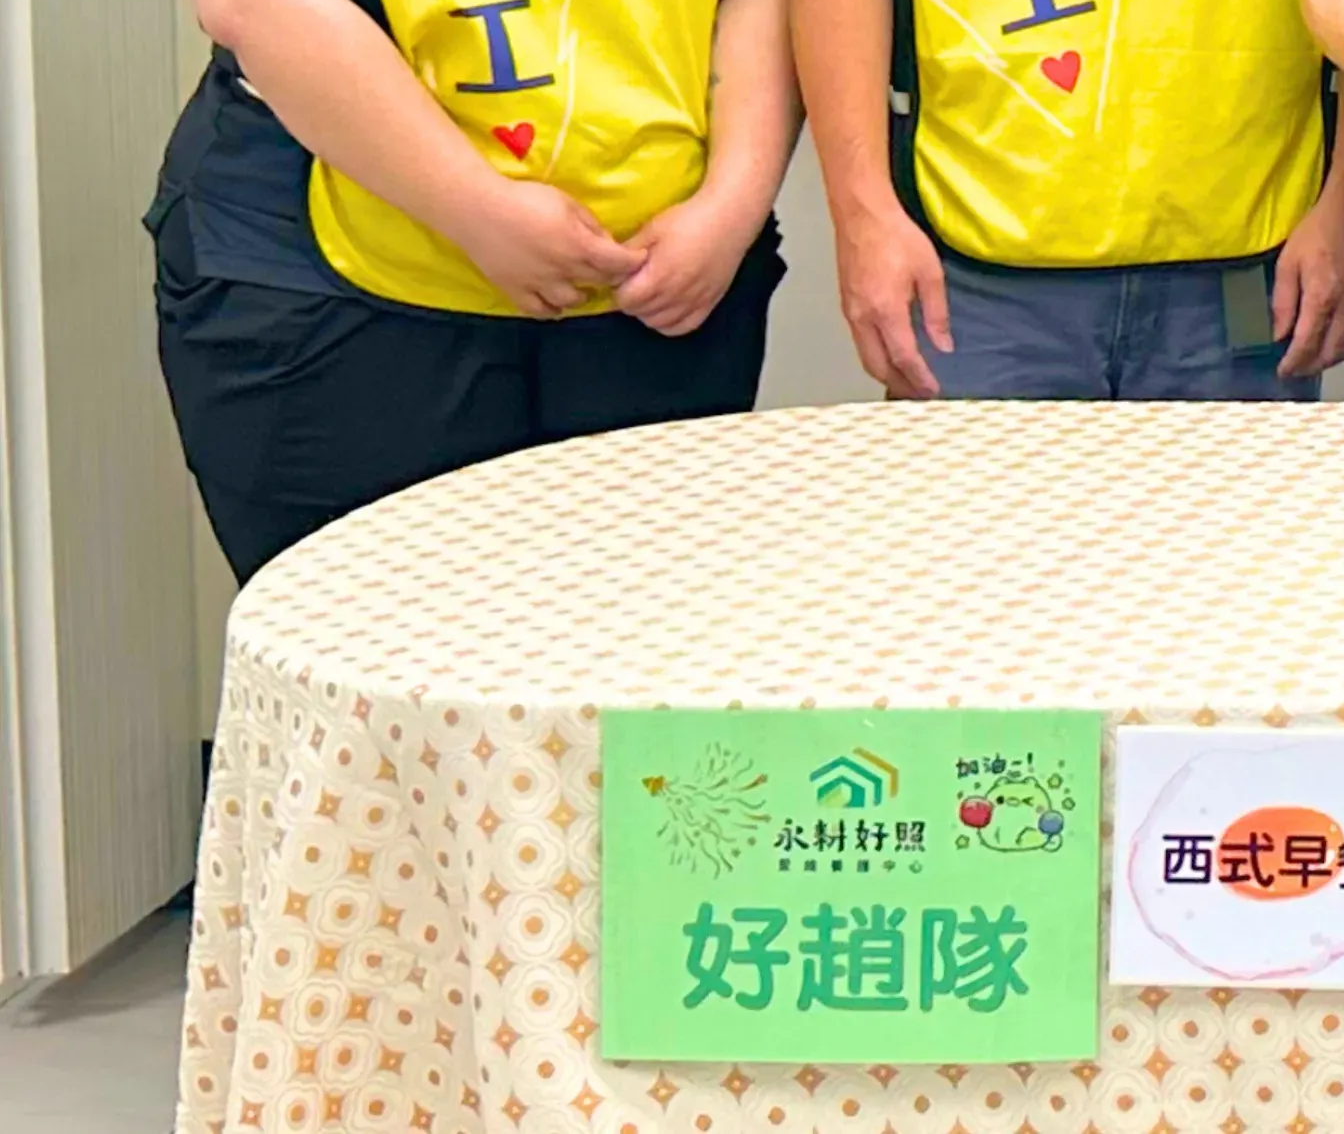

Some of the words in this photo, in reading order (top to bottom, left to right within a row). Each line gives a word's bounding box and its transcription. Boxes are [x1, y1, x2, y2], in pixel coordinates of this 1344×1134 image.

[773, 818, 926, 853] 永耕好照
[682, 902, 1030, 1013] 好趙隊
